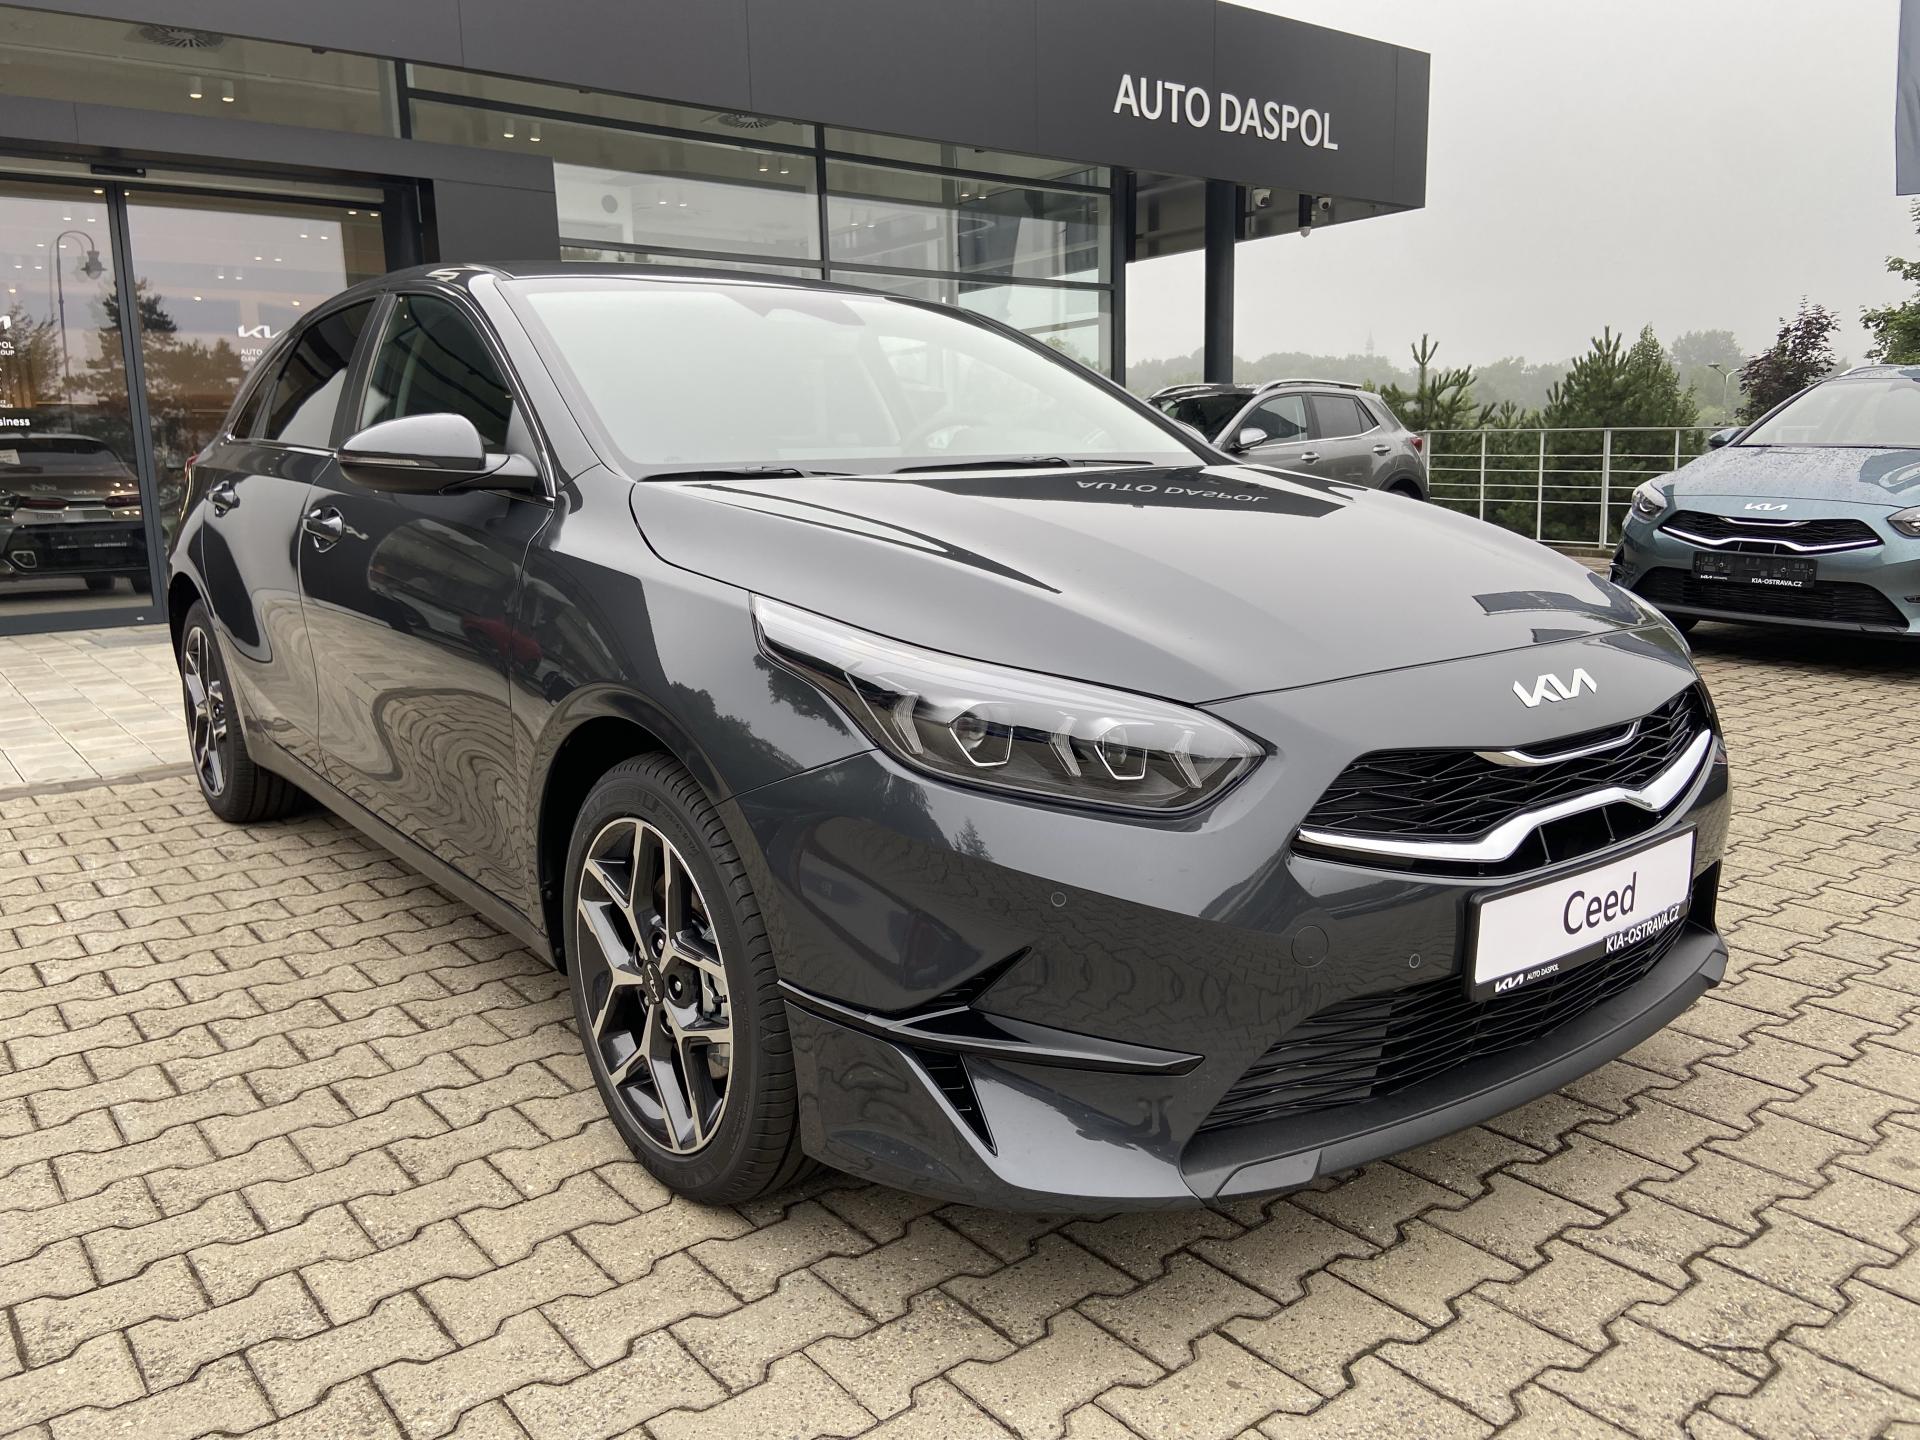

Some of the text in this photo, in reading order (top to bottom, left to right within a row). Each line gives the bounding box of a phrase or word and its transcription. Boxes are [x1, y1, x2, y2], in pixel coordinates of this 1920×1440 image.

[1113, 73, 1339, 151] AUTO DASPOL
[241, 348, 263, 356] AUTO
[1751, 577, 1803, 588] KIA-OSTRAVA.CZ
[1512, 668, 1597, 708] KIA
[1563, 871, 1638, 935] Ceed
[1605, 904, 1680, 954] KIA-OSTRAVA.CZ
[1494, 963, 1560, 993] KIA AUTO DASPOL
